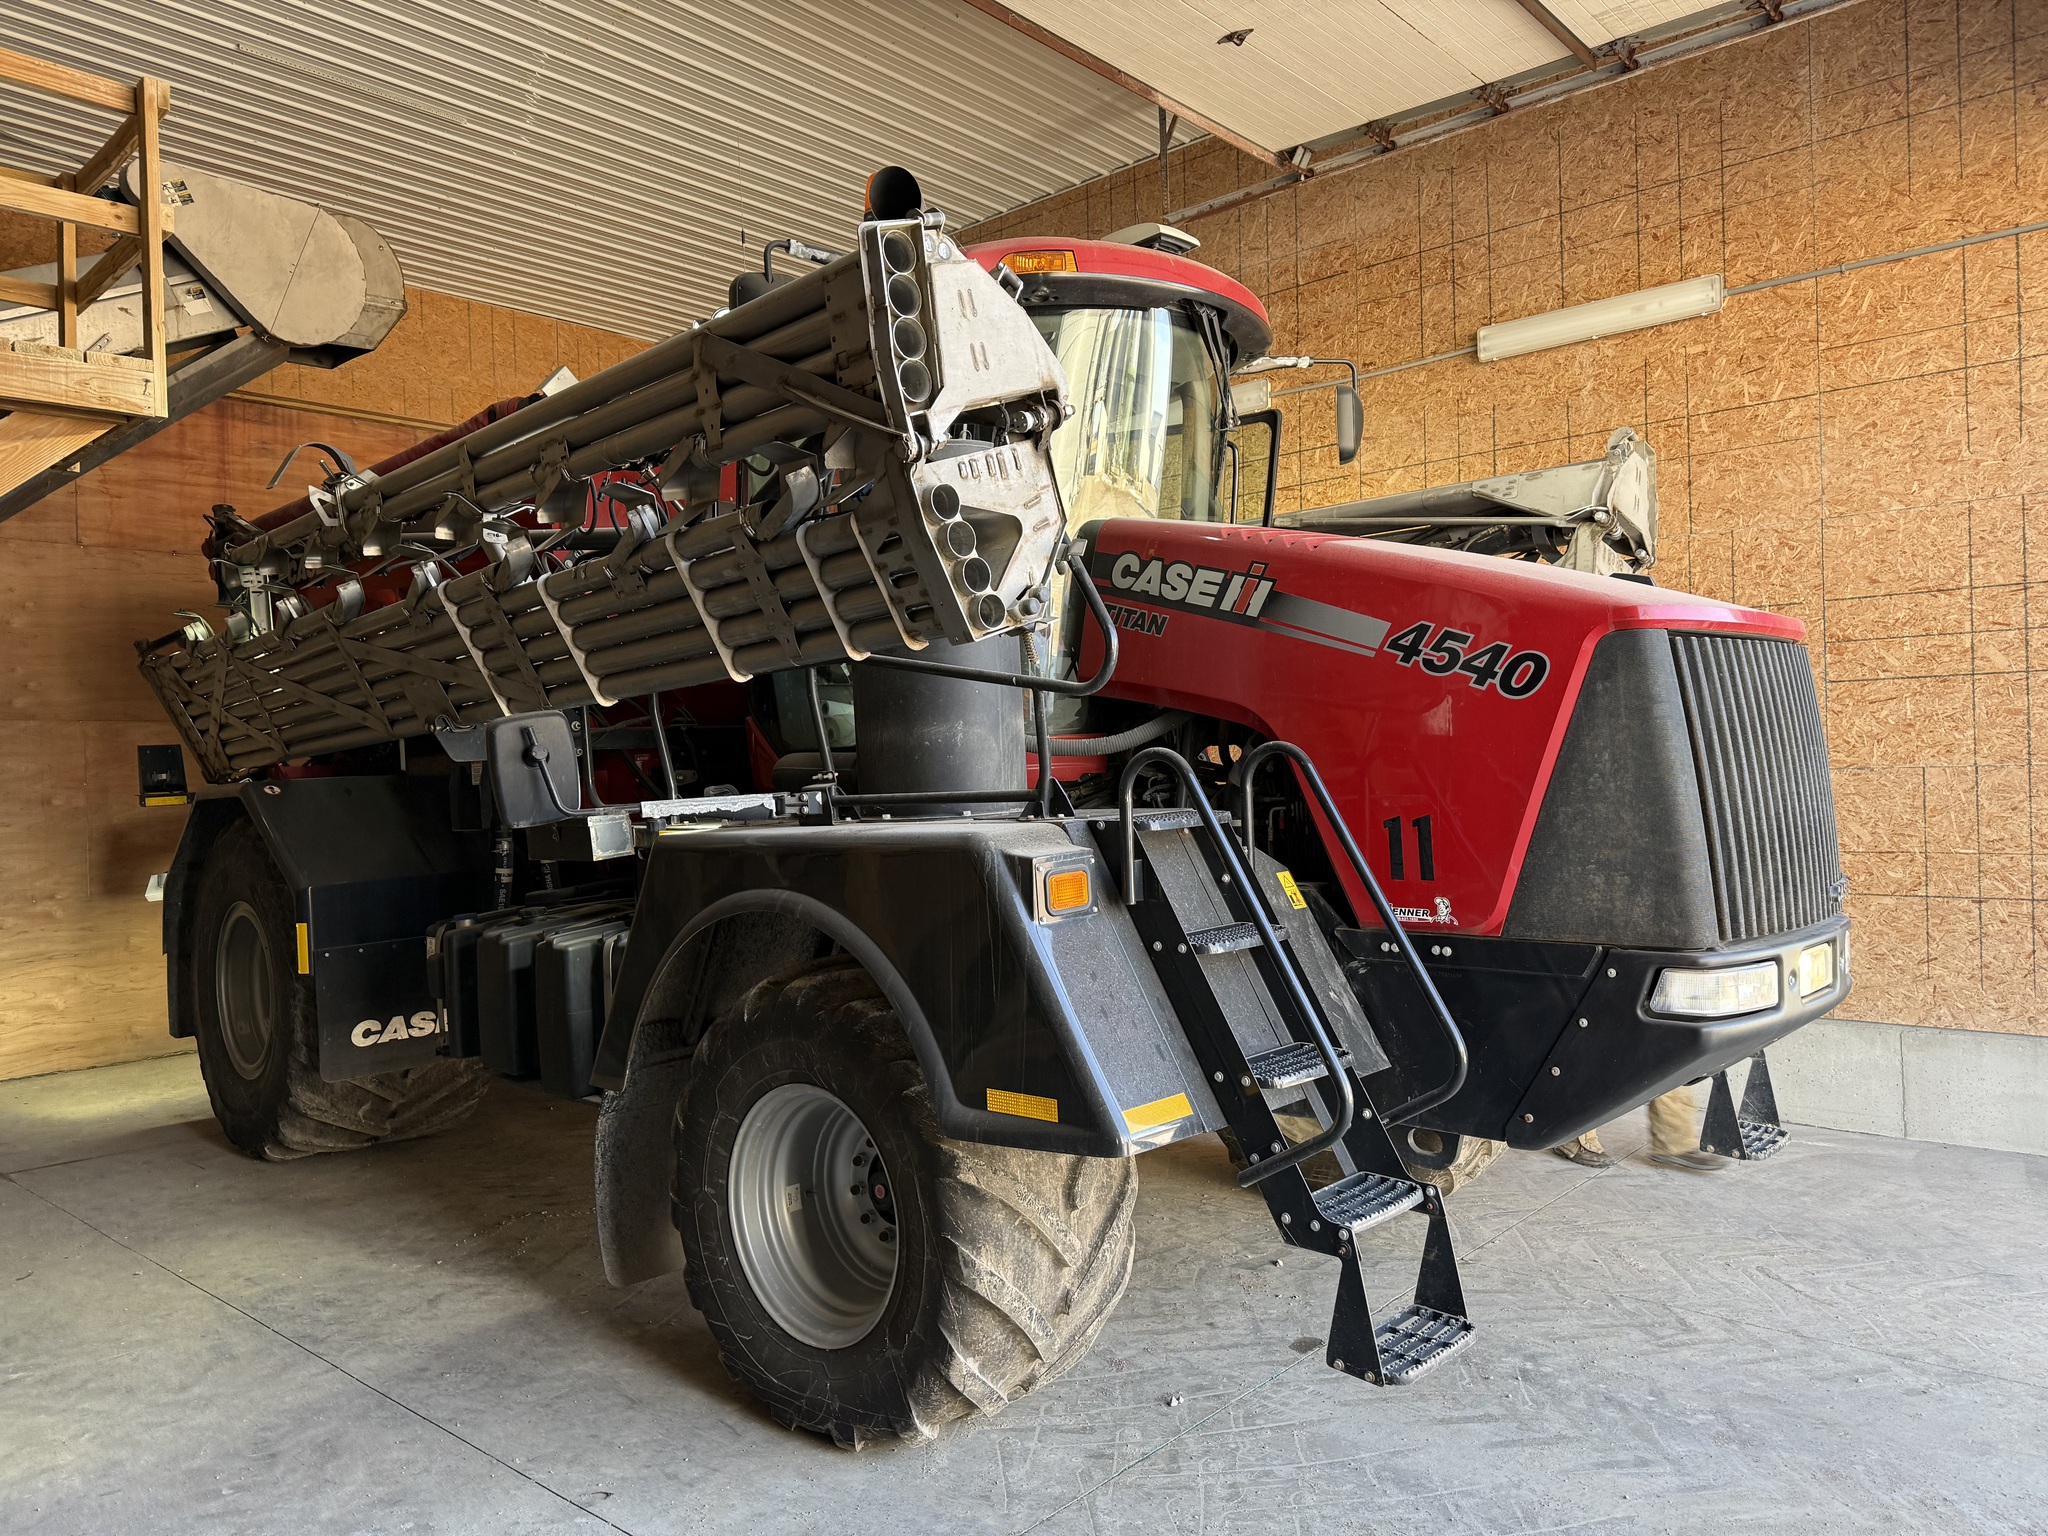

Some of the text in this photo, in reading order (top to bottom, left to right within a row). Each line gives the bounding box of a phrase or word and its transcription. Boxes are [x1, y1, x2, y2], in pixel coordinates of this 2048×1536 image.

[1111, 553, 1226, 608] CASE
[1383, 620, 1550, 699] 4540
[1383, 814, 1435, 881] 11
[1389, 904, 1429, 918] ENNER
